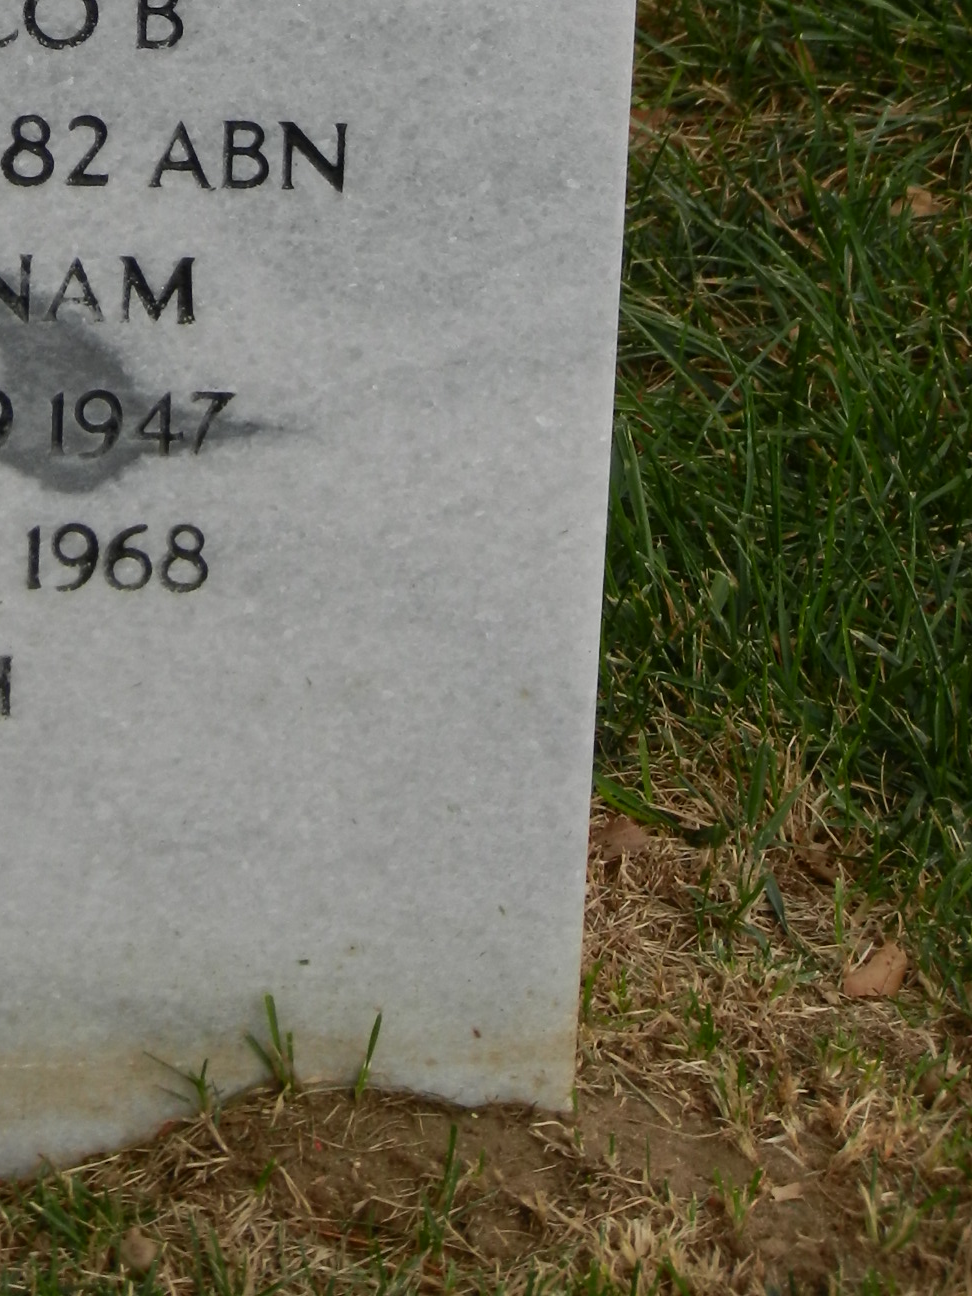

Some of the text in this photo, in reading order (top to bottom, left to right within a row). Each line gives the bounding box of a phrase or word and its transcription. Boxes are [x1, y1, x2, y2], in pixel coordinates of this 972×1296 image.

[0, 113, 110, 188] 82
[147, 120, 349, 193] ABN
[50, 389, 238, 458] 1947
[25, 522, 209, 594] 1968
